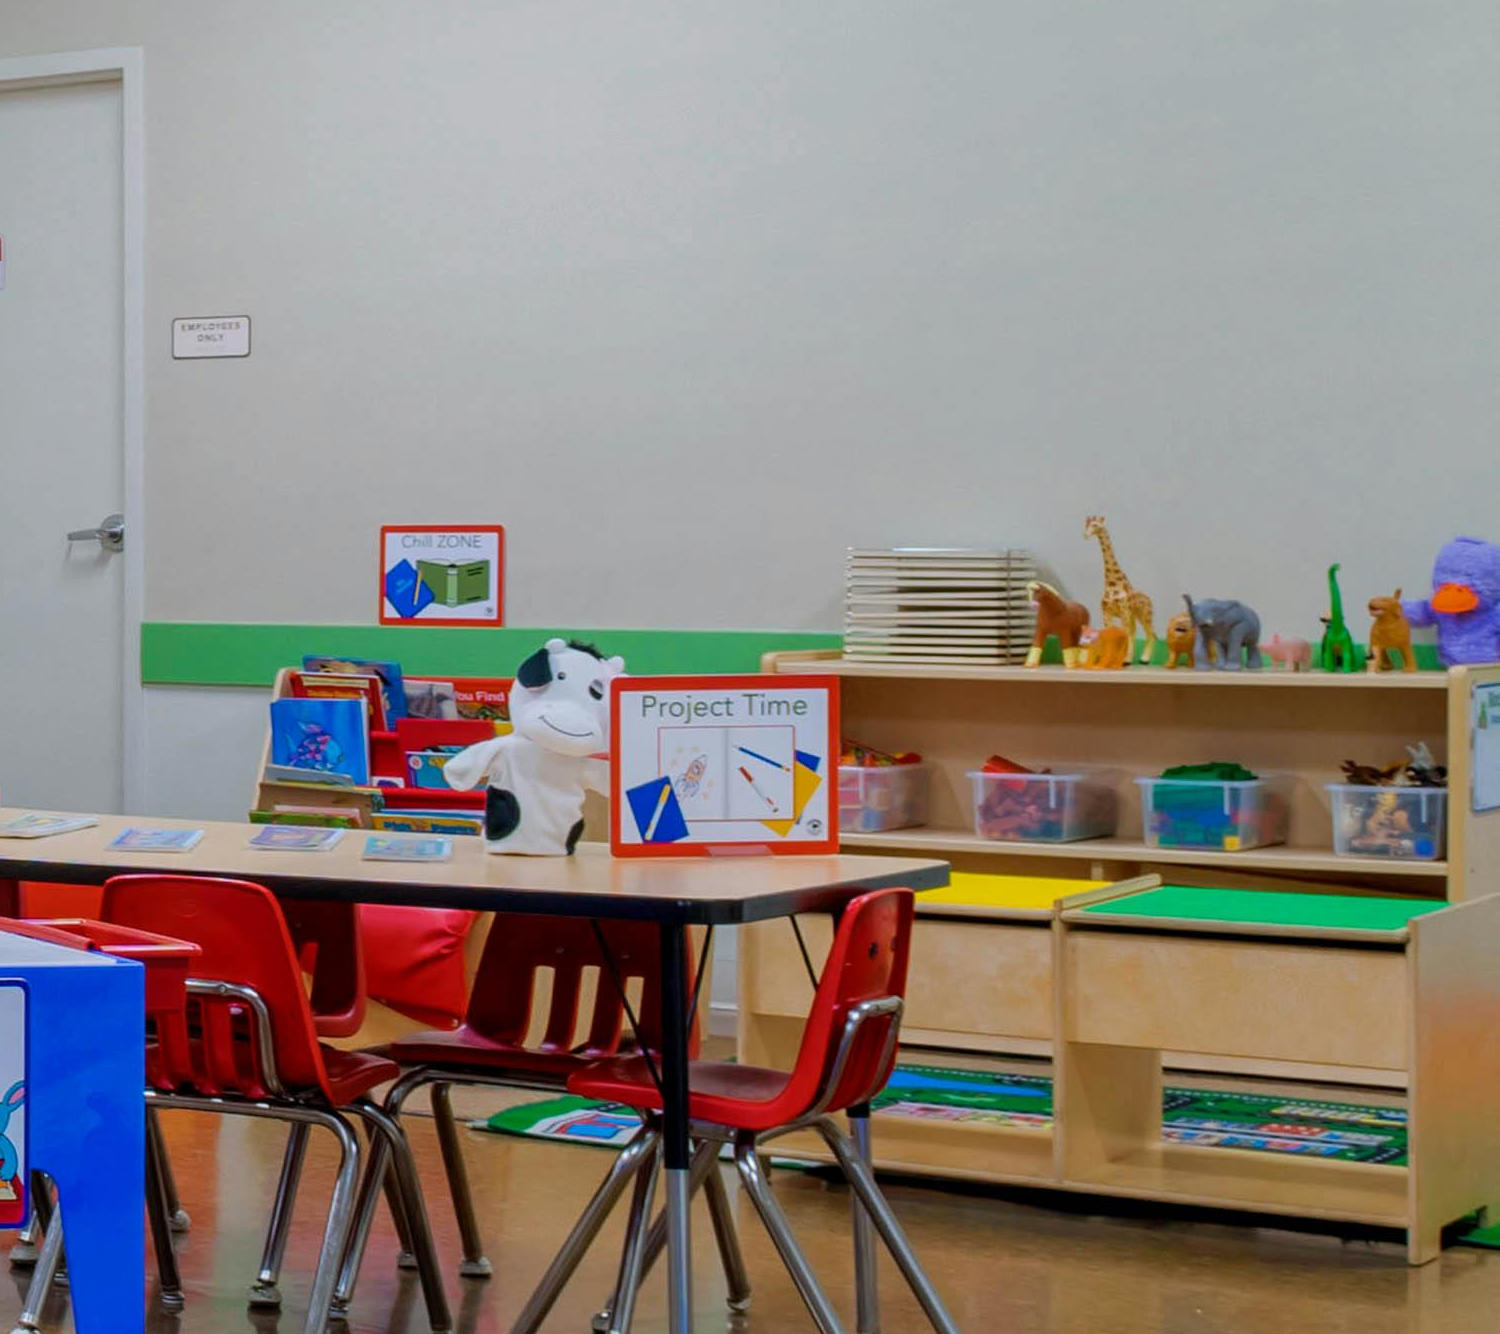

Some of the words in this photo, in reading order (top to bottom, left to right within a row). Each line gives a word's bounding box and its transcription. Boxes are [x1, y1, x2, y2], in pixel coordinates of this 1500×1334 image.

[181, 321, 241, 332] EMPLOYEES
[197, 333, 224, 342] ONLY
[401, 534, 433, 548] Chill
[437, 534, 483, 548] ZONE
[476, 691, 506, 701] Find
[641, 694, 734, 724] Project
[742, 693, 808, 717] Time
